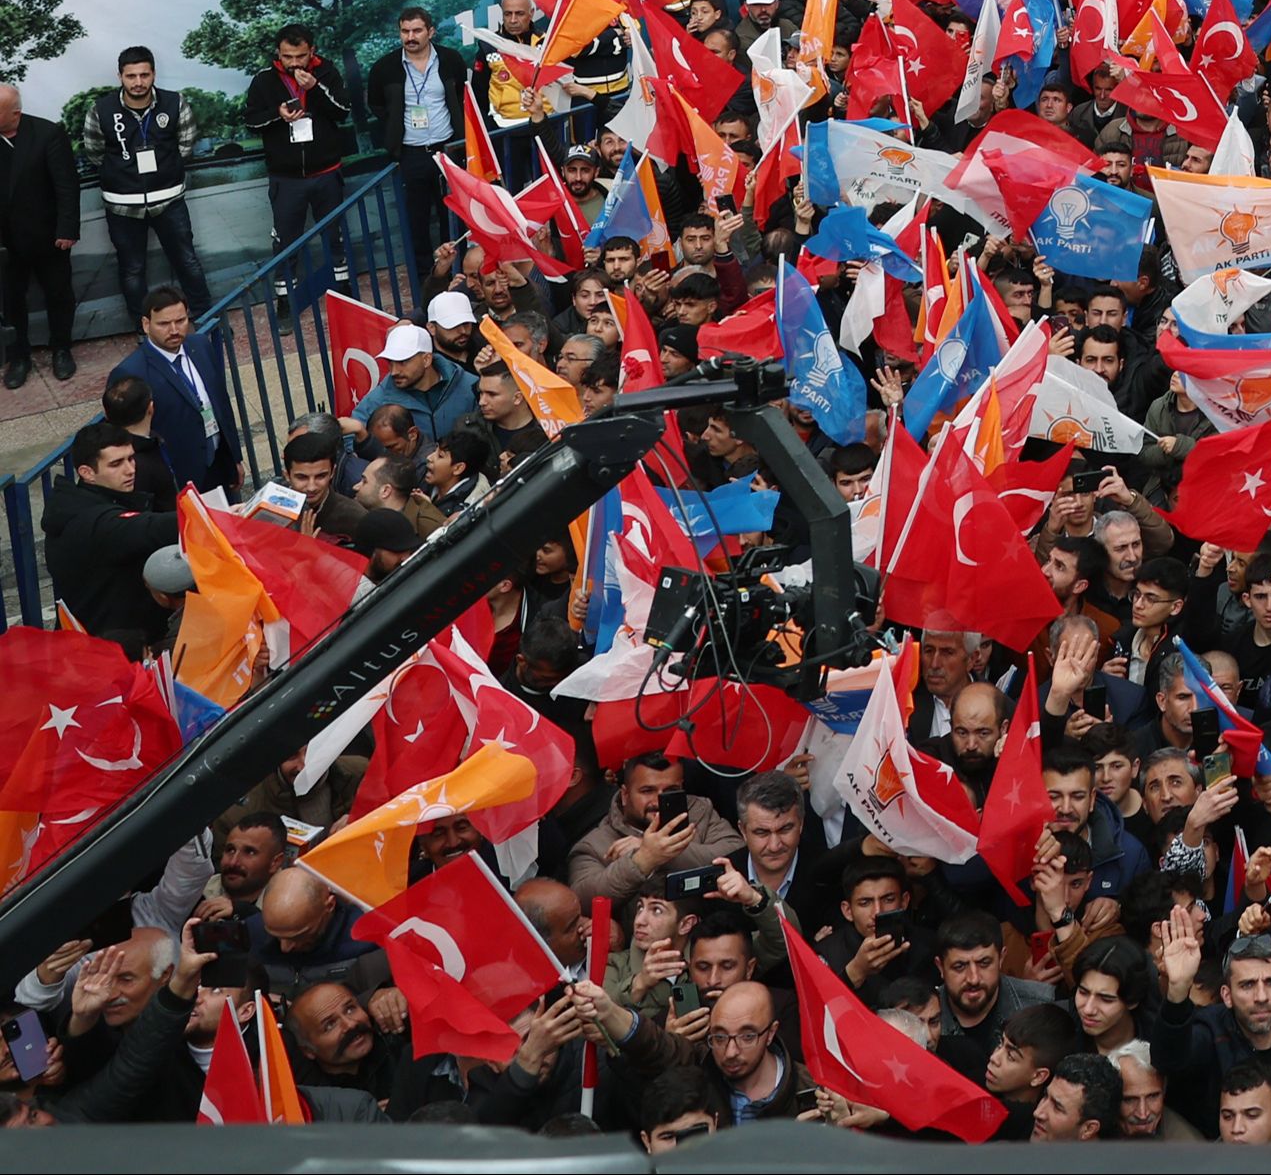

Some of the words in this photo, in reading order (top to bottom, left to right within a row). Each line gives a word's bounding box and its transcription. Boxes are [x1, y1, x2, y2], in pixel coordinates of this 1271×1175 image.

[567, 145, 592, 158] EA7
[1215, 260, 1232, 271] AK
[331, 628, 420, 701] Altus
[845, 772, 863, 797] AK
